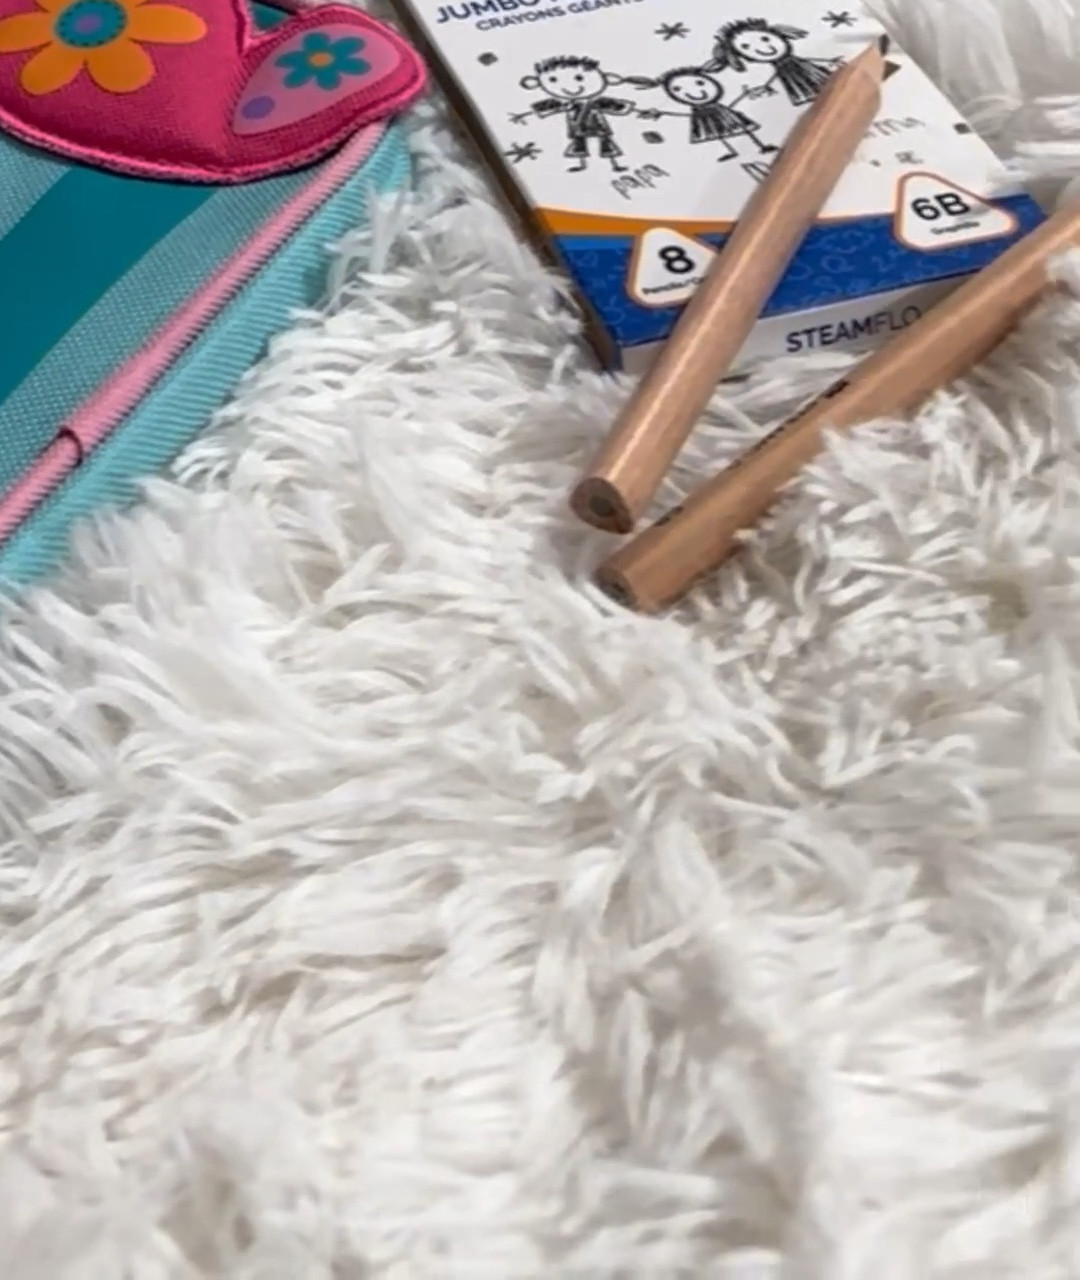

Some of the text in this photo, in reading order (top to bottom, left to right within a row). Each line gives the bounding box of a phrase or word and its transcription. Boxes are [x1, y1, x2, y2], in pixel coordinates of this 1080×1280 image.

[475, 7, 566, 32] CRAYONS
[911, 192, 970, 221] 6B
[658, 245, 695, 275] 8
[786, 305, 921, 354] STEAMFLO
